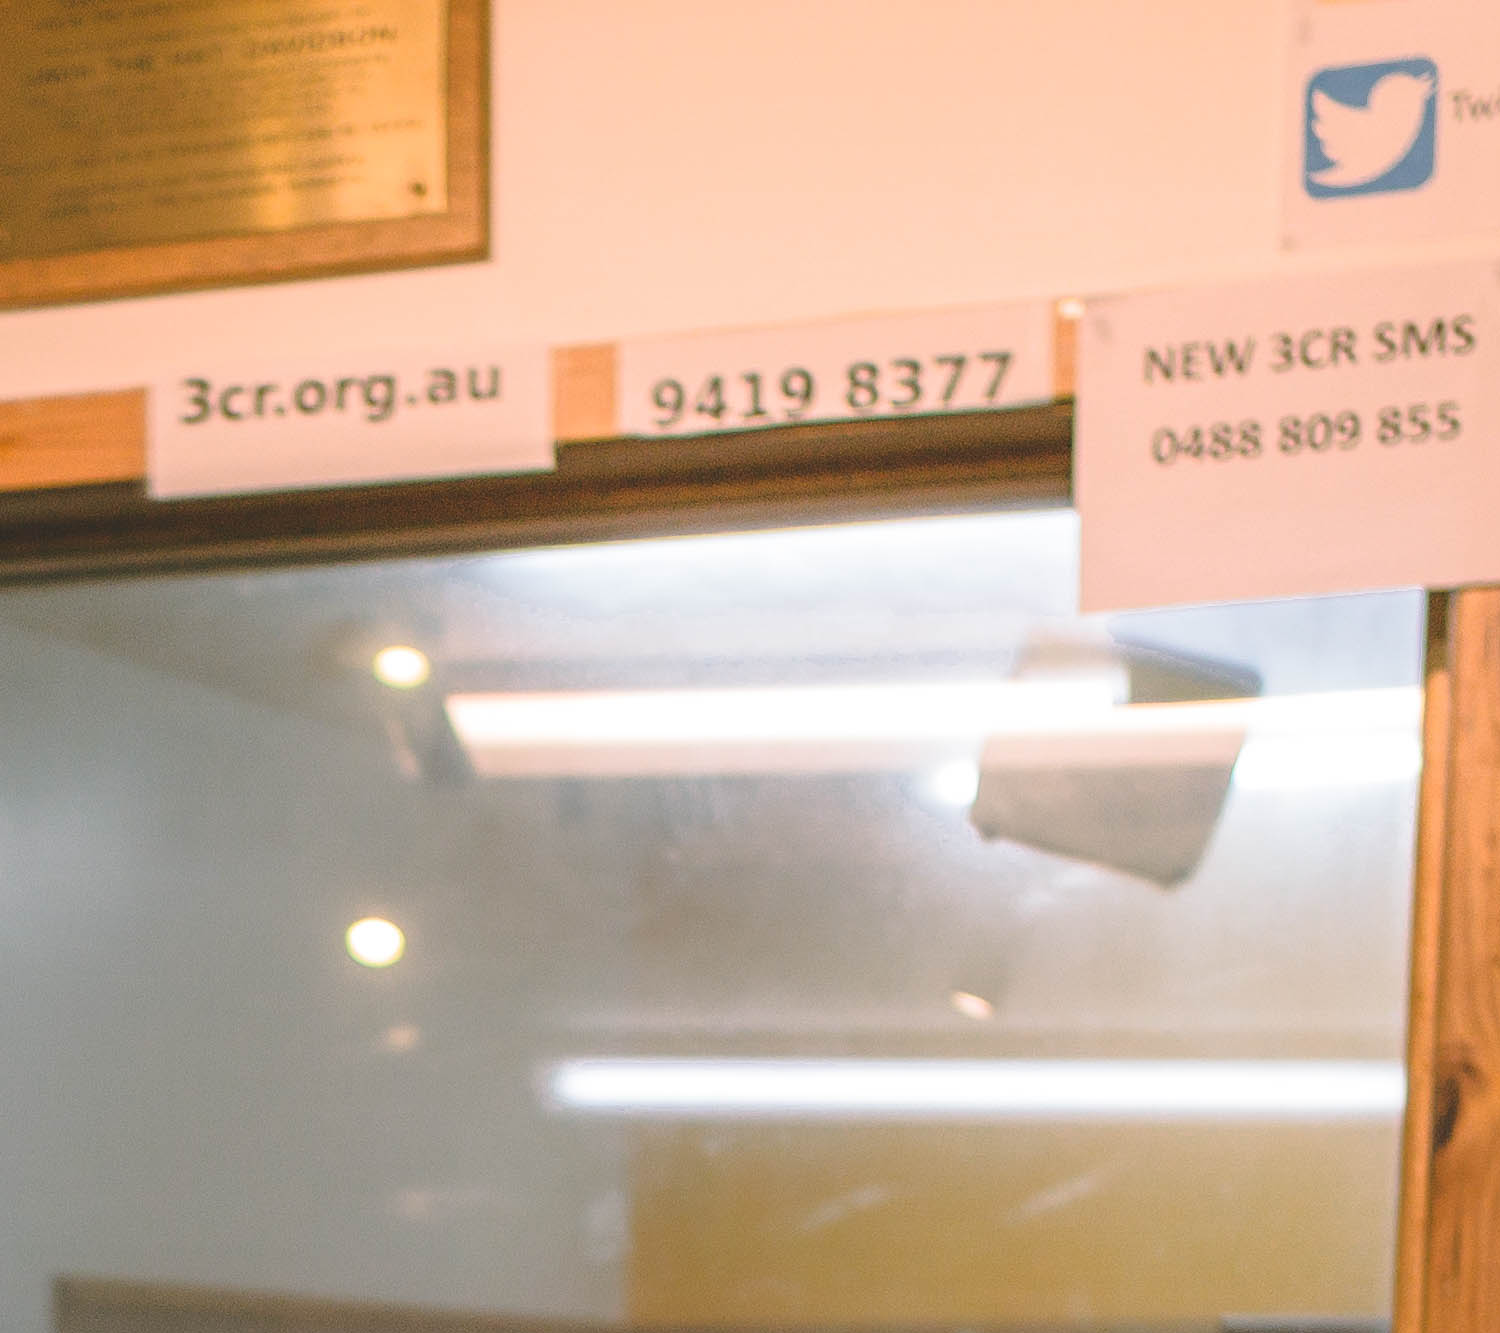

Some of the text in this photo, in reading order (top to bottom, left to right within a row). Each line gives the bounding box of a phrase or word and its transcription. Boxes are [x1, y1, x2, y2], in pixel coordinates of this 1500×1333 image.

[1142, 313, 1477, 385] NEW 3CR SMS
[179, 364, 502, 425] 3cr.org.au
[651, 350, 1012, 427] 9419 8377
[1150, 399, 1463, 467] 0488 809 855
